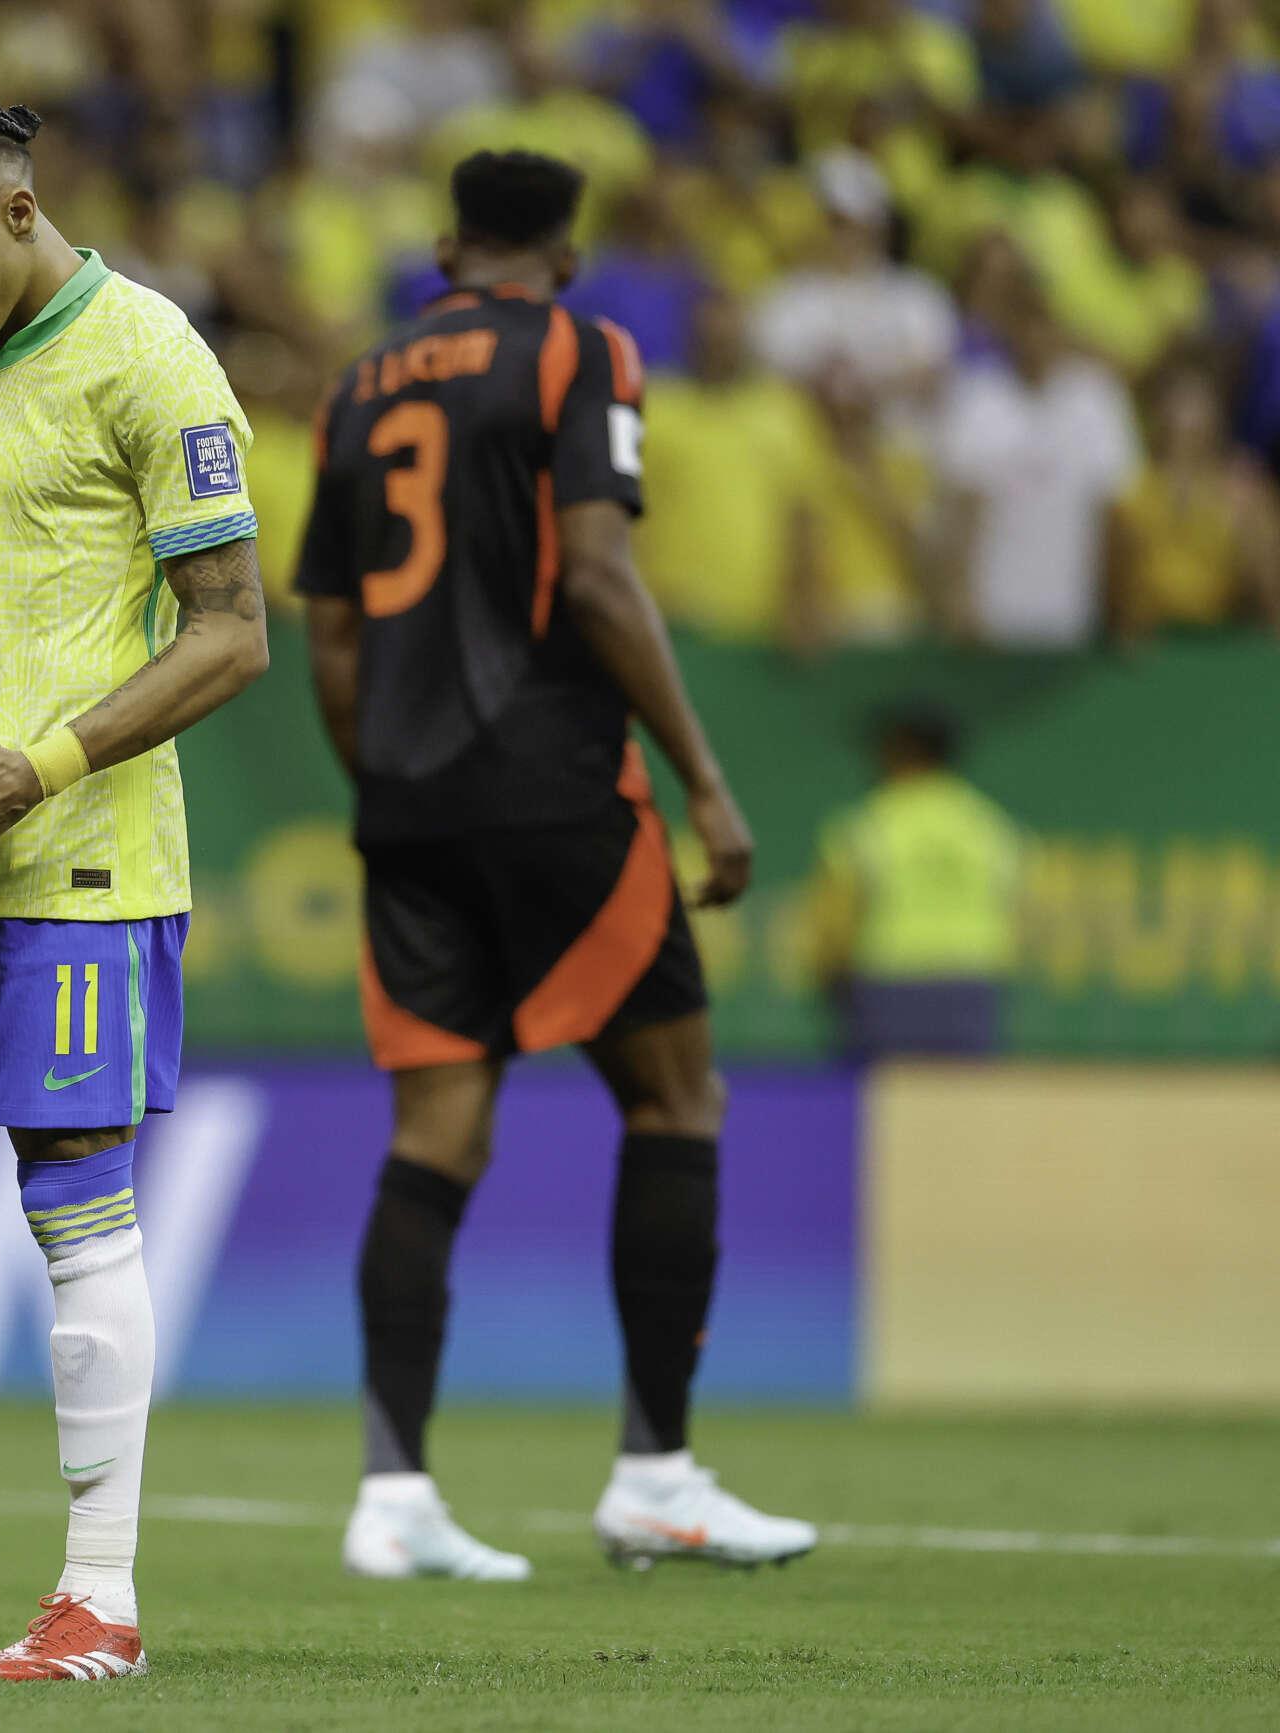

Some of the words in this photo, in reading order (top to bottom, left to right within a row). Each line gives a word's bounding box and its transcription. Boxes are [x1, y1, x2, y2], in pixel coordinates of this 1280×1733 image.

[197, 462, 212, 474] the
[198, 445, 228, 461] UNITES
[361, 400, 448, 619] 3
[55, 963, 99, 1055] 11
